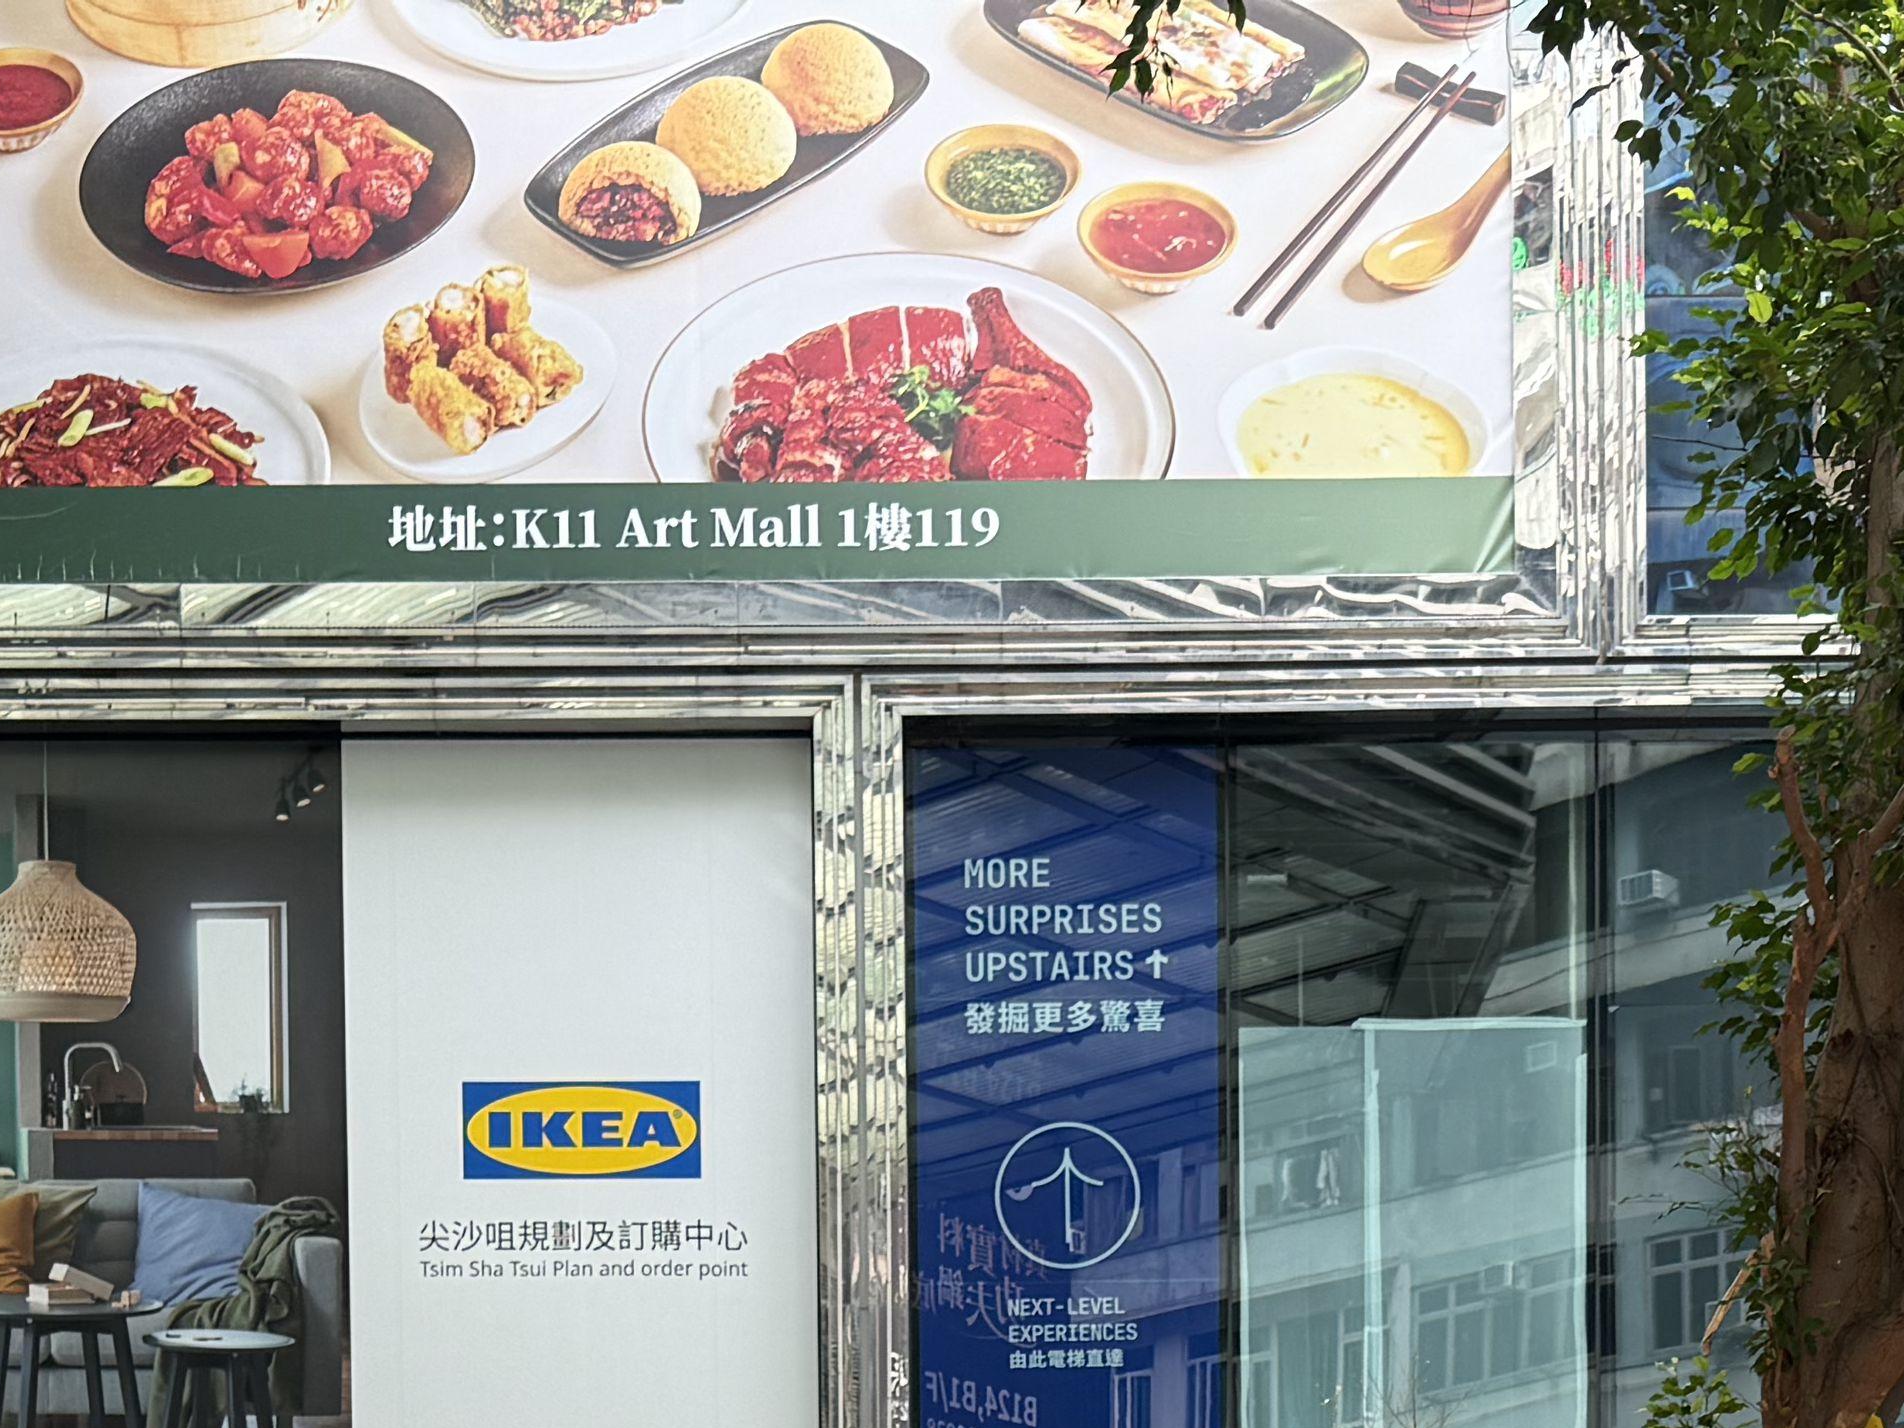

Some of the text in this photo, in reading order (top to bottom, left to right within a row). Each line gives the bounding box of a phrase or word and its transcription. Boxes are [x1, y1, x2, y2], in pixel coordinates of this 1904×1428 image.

[615, 504, 699, 549] Art
[709, 503, 823, 549] Mall
[836, 502, 1001, 552] 1樓119
[964, 857, 1051, 889] MORE
[964, 902, 1163, 936] SURPRISES
[965, 949, 1134, 983] UPSTAIRS
[963, 998, 1166, 1035] 發掘更多驚喜
[487, 1110, 682, 1149] IKEA
[418, 1219, 749, 1252] 尖沙咀規劃及訂購中心
[420, 1259, 749, 1281] Tsim Sha Tsui Plan and order point
[1006, 1296, 1126, 1317] NEXT-LEVEL
[1008, 1323, 1139, 1343] EXPERIENCES
[1009, 1349, 1125, 1369] 由此電梯直達
